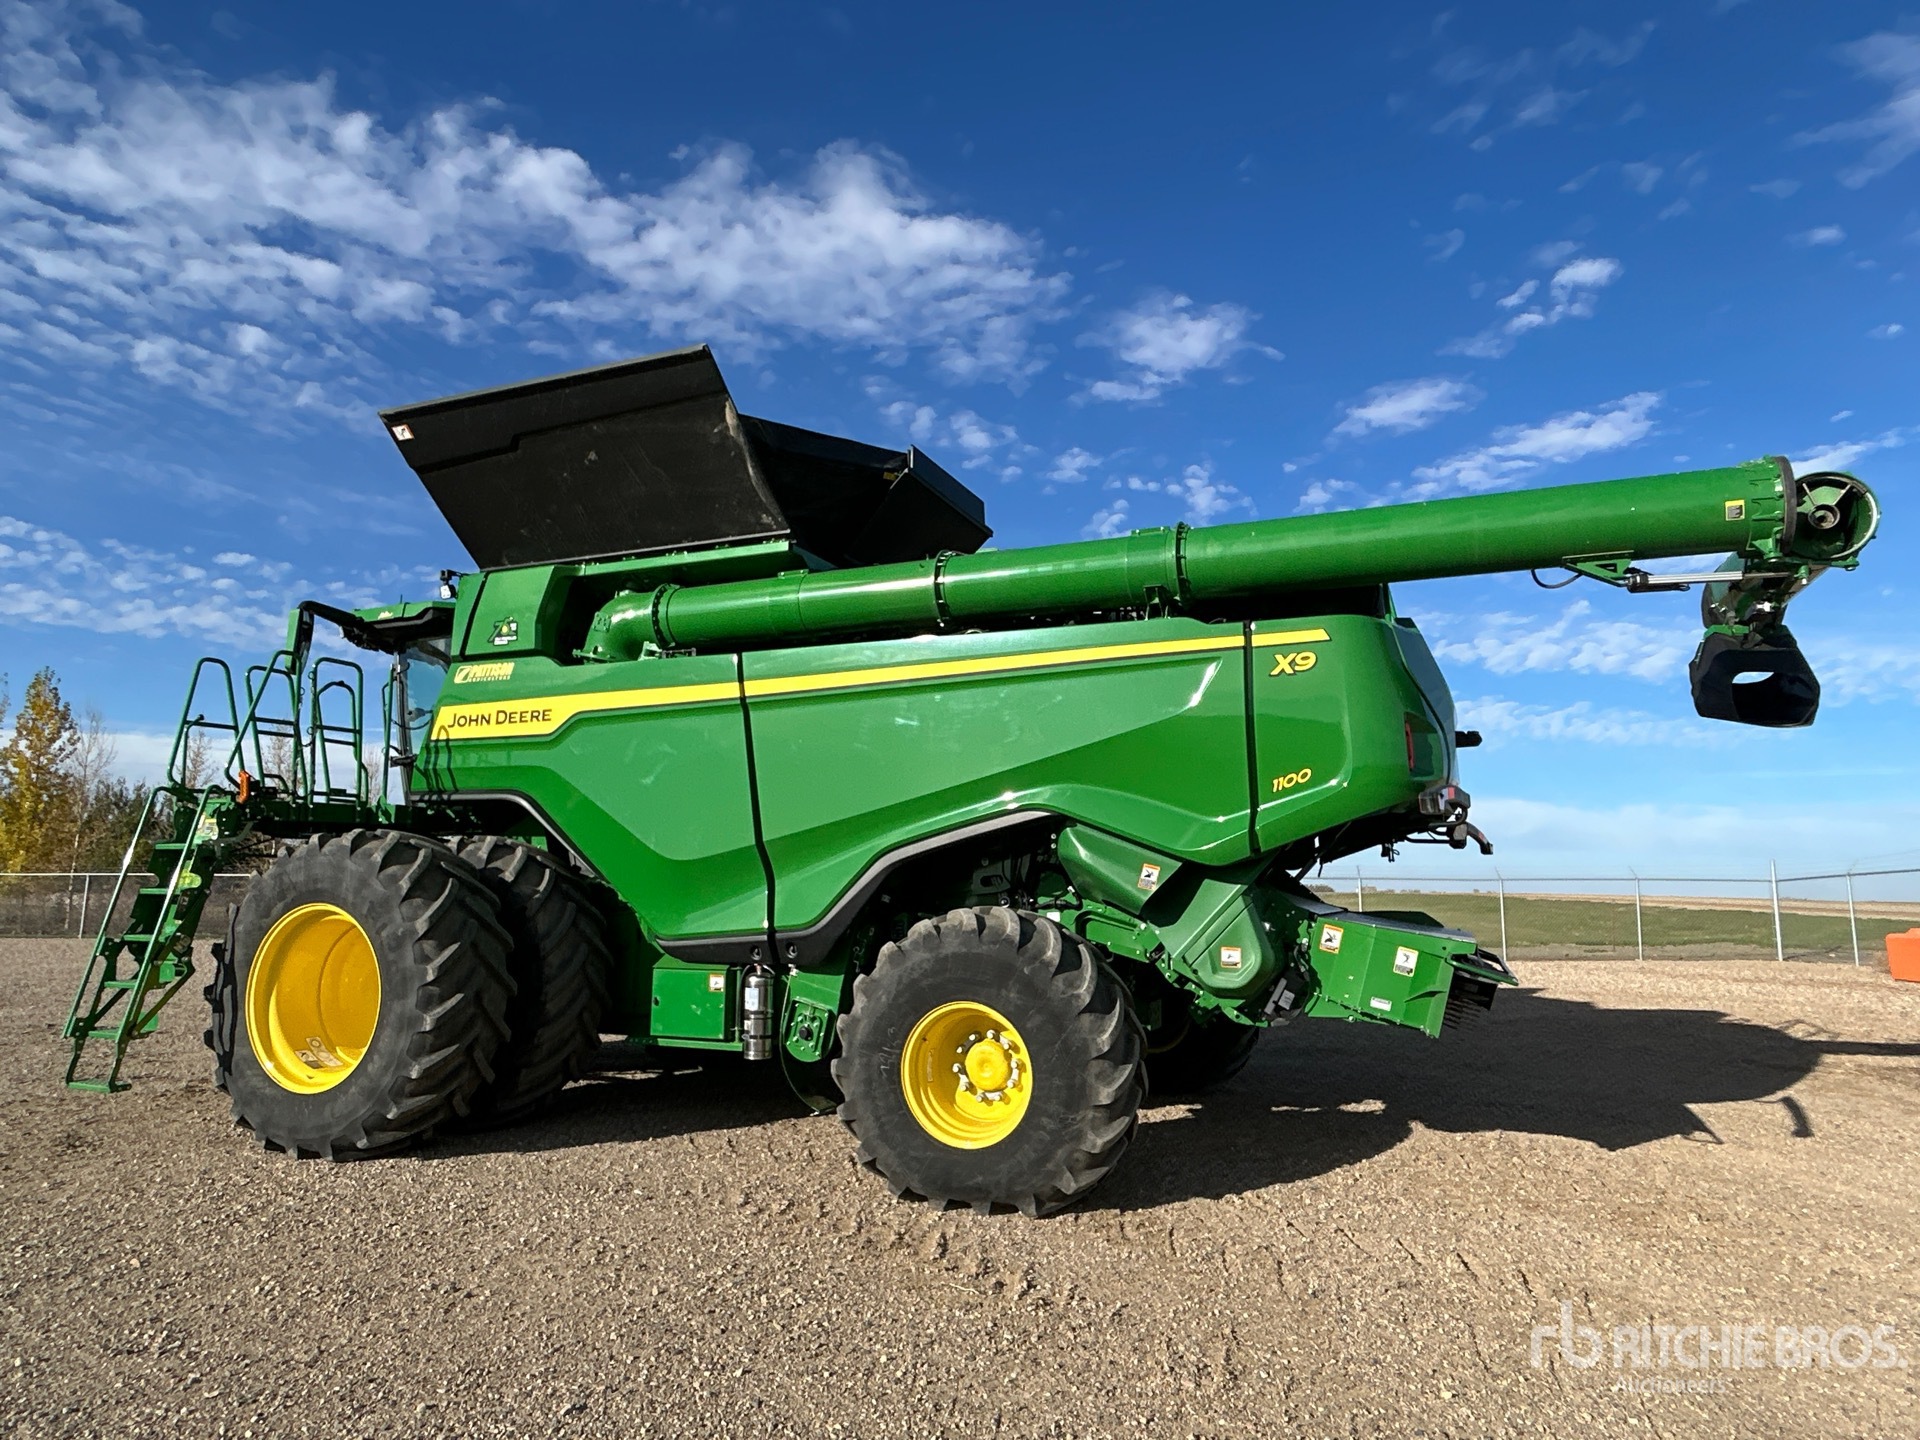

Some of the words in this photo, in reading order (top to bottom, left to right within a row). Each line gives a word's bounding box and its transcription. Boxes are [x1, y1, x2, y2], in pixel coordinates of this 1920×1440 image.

[470, 662, 515, 678] PATTISON
[1270, 651, 1317, 676] X9
[448, 713, 491, 728] JOHN
[495, 709, 552, 725] DEERE
[1272, 768, 1312, 792] 1100
